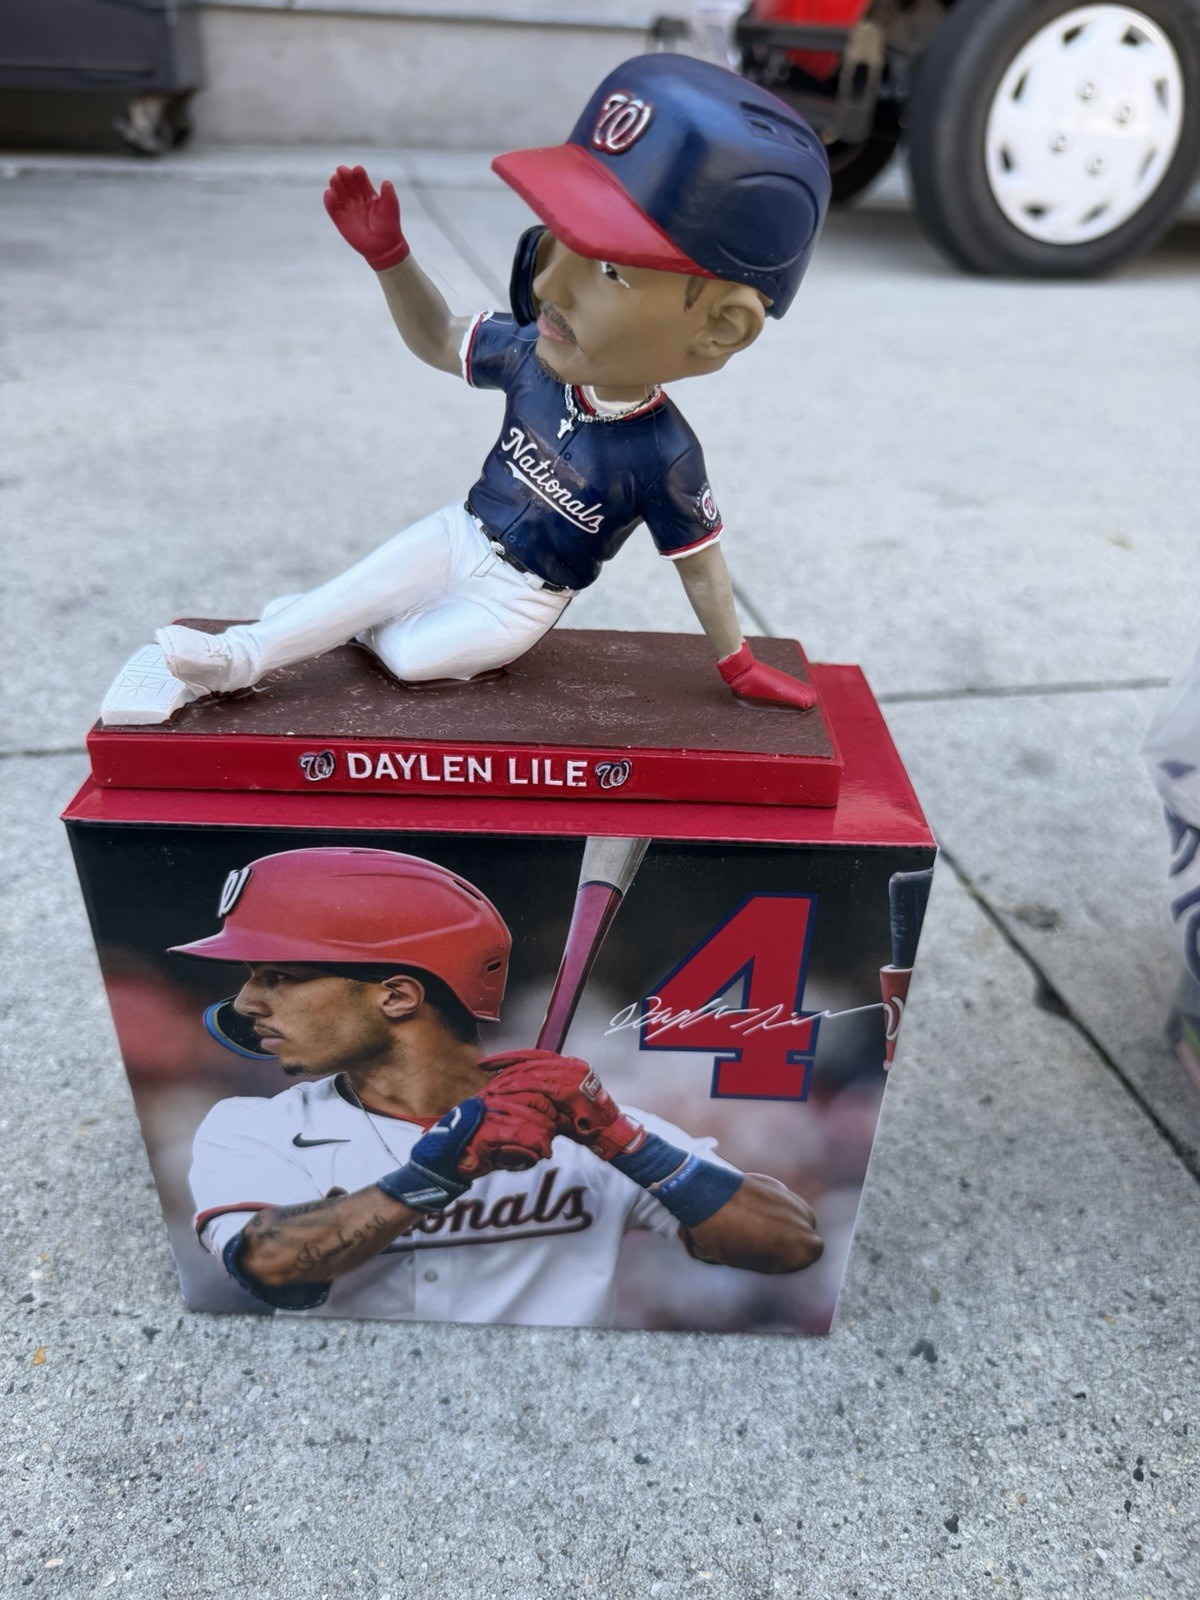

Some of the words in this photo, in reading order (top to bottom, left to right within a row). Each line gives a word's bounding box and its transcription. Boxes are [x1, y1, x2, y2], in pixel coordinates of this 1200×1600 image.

[592, 91, 653, 153] W
[500, 426, 605, 534] Nationals
[298, 750, 336, 782] W
[346, 751, 493, 783] DAYLEN
[508, 757, 588, 788] LILE
[595, 760, 631, 789] W
[639, 891, 820, 1102] 4
[400, 1166, 594, 1238] onals
